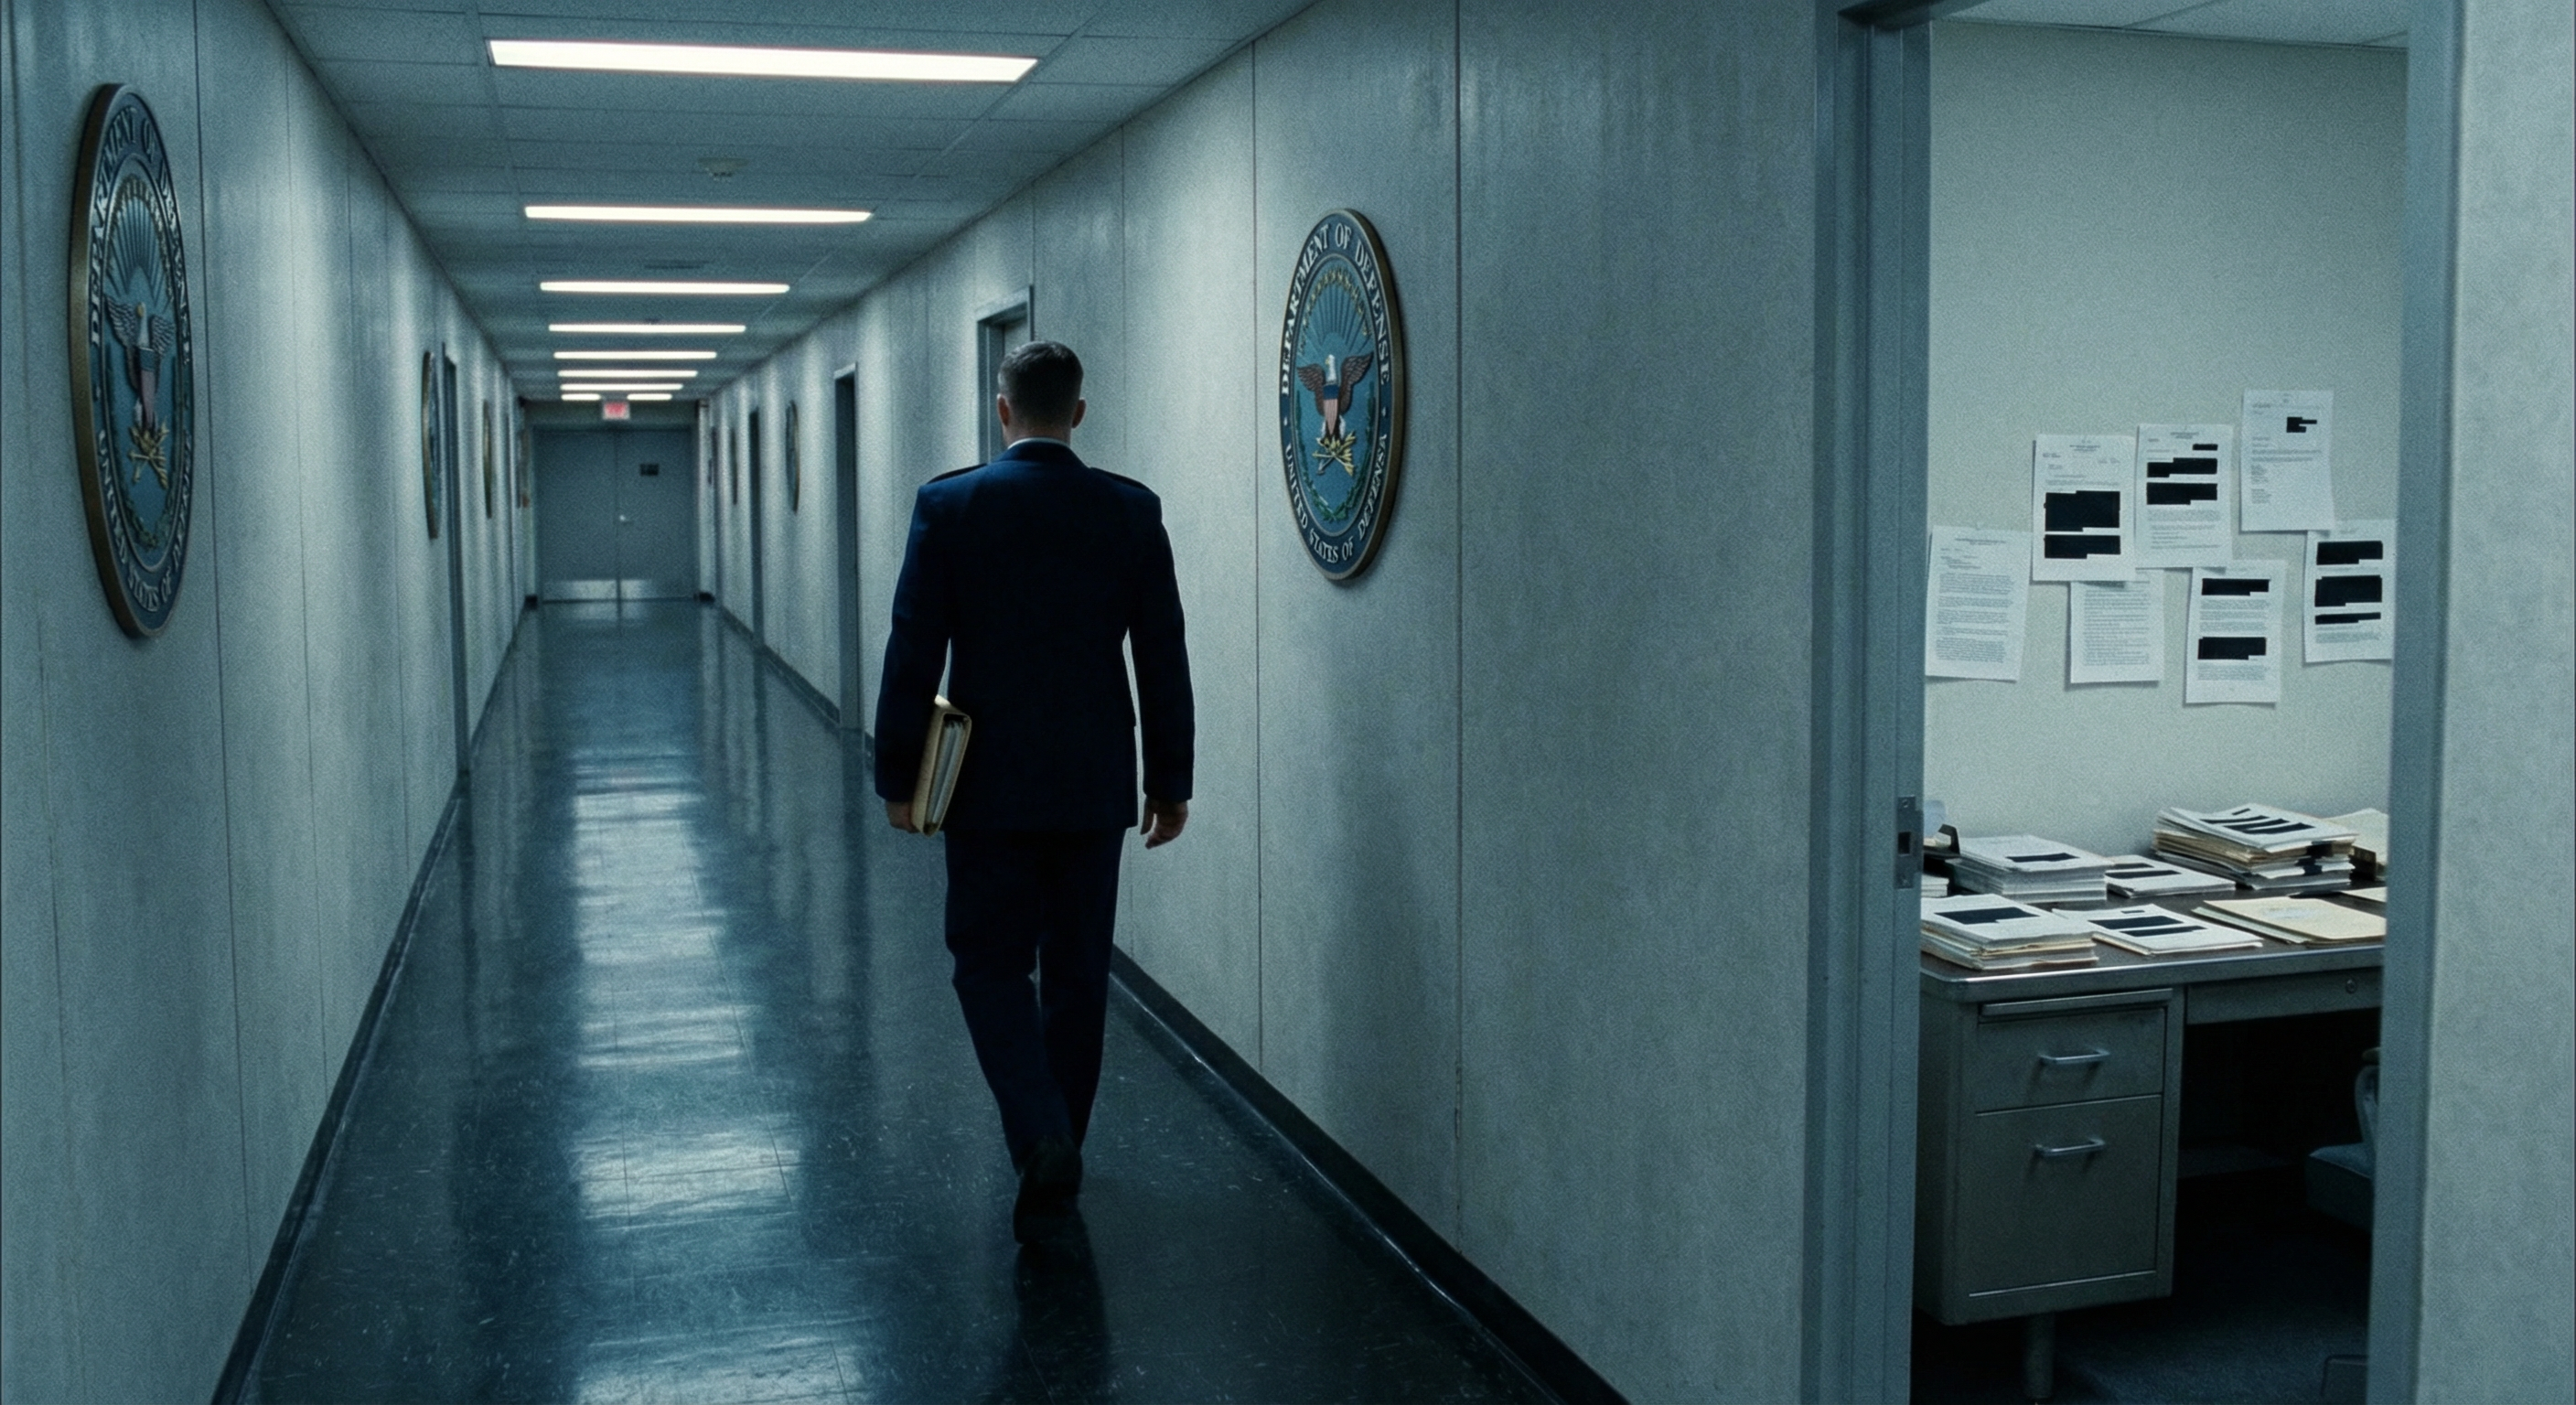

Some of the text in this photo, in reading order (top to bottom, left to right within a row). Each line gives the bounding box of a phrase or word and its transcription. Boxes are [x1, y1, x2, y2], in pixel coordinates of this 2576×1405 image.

[1282, 222, 1390, 395] DEPARTMENT OF DEFENSE
[1285, 443, 1309, 530] UNITED
[1341, 536, 1354, 561] OF
